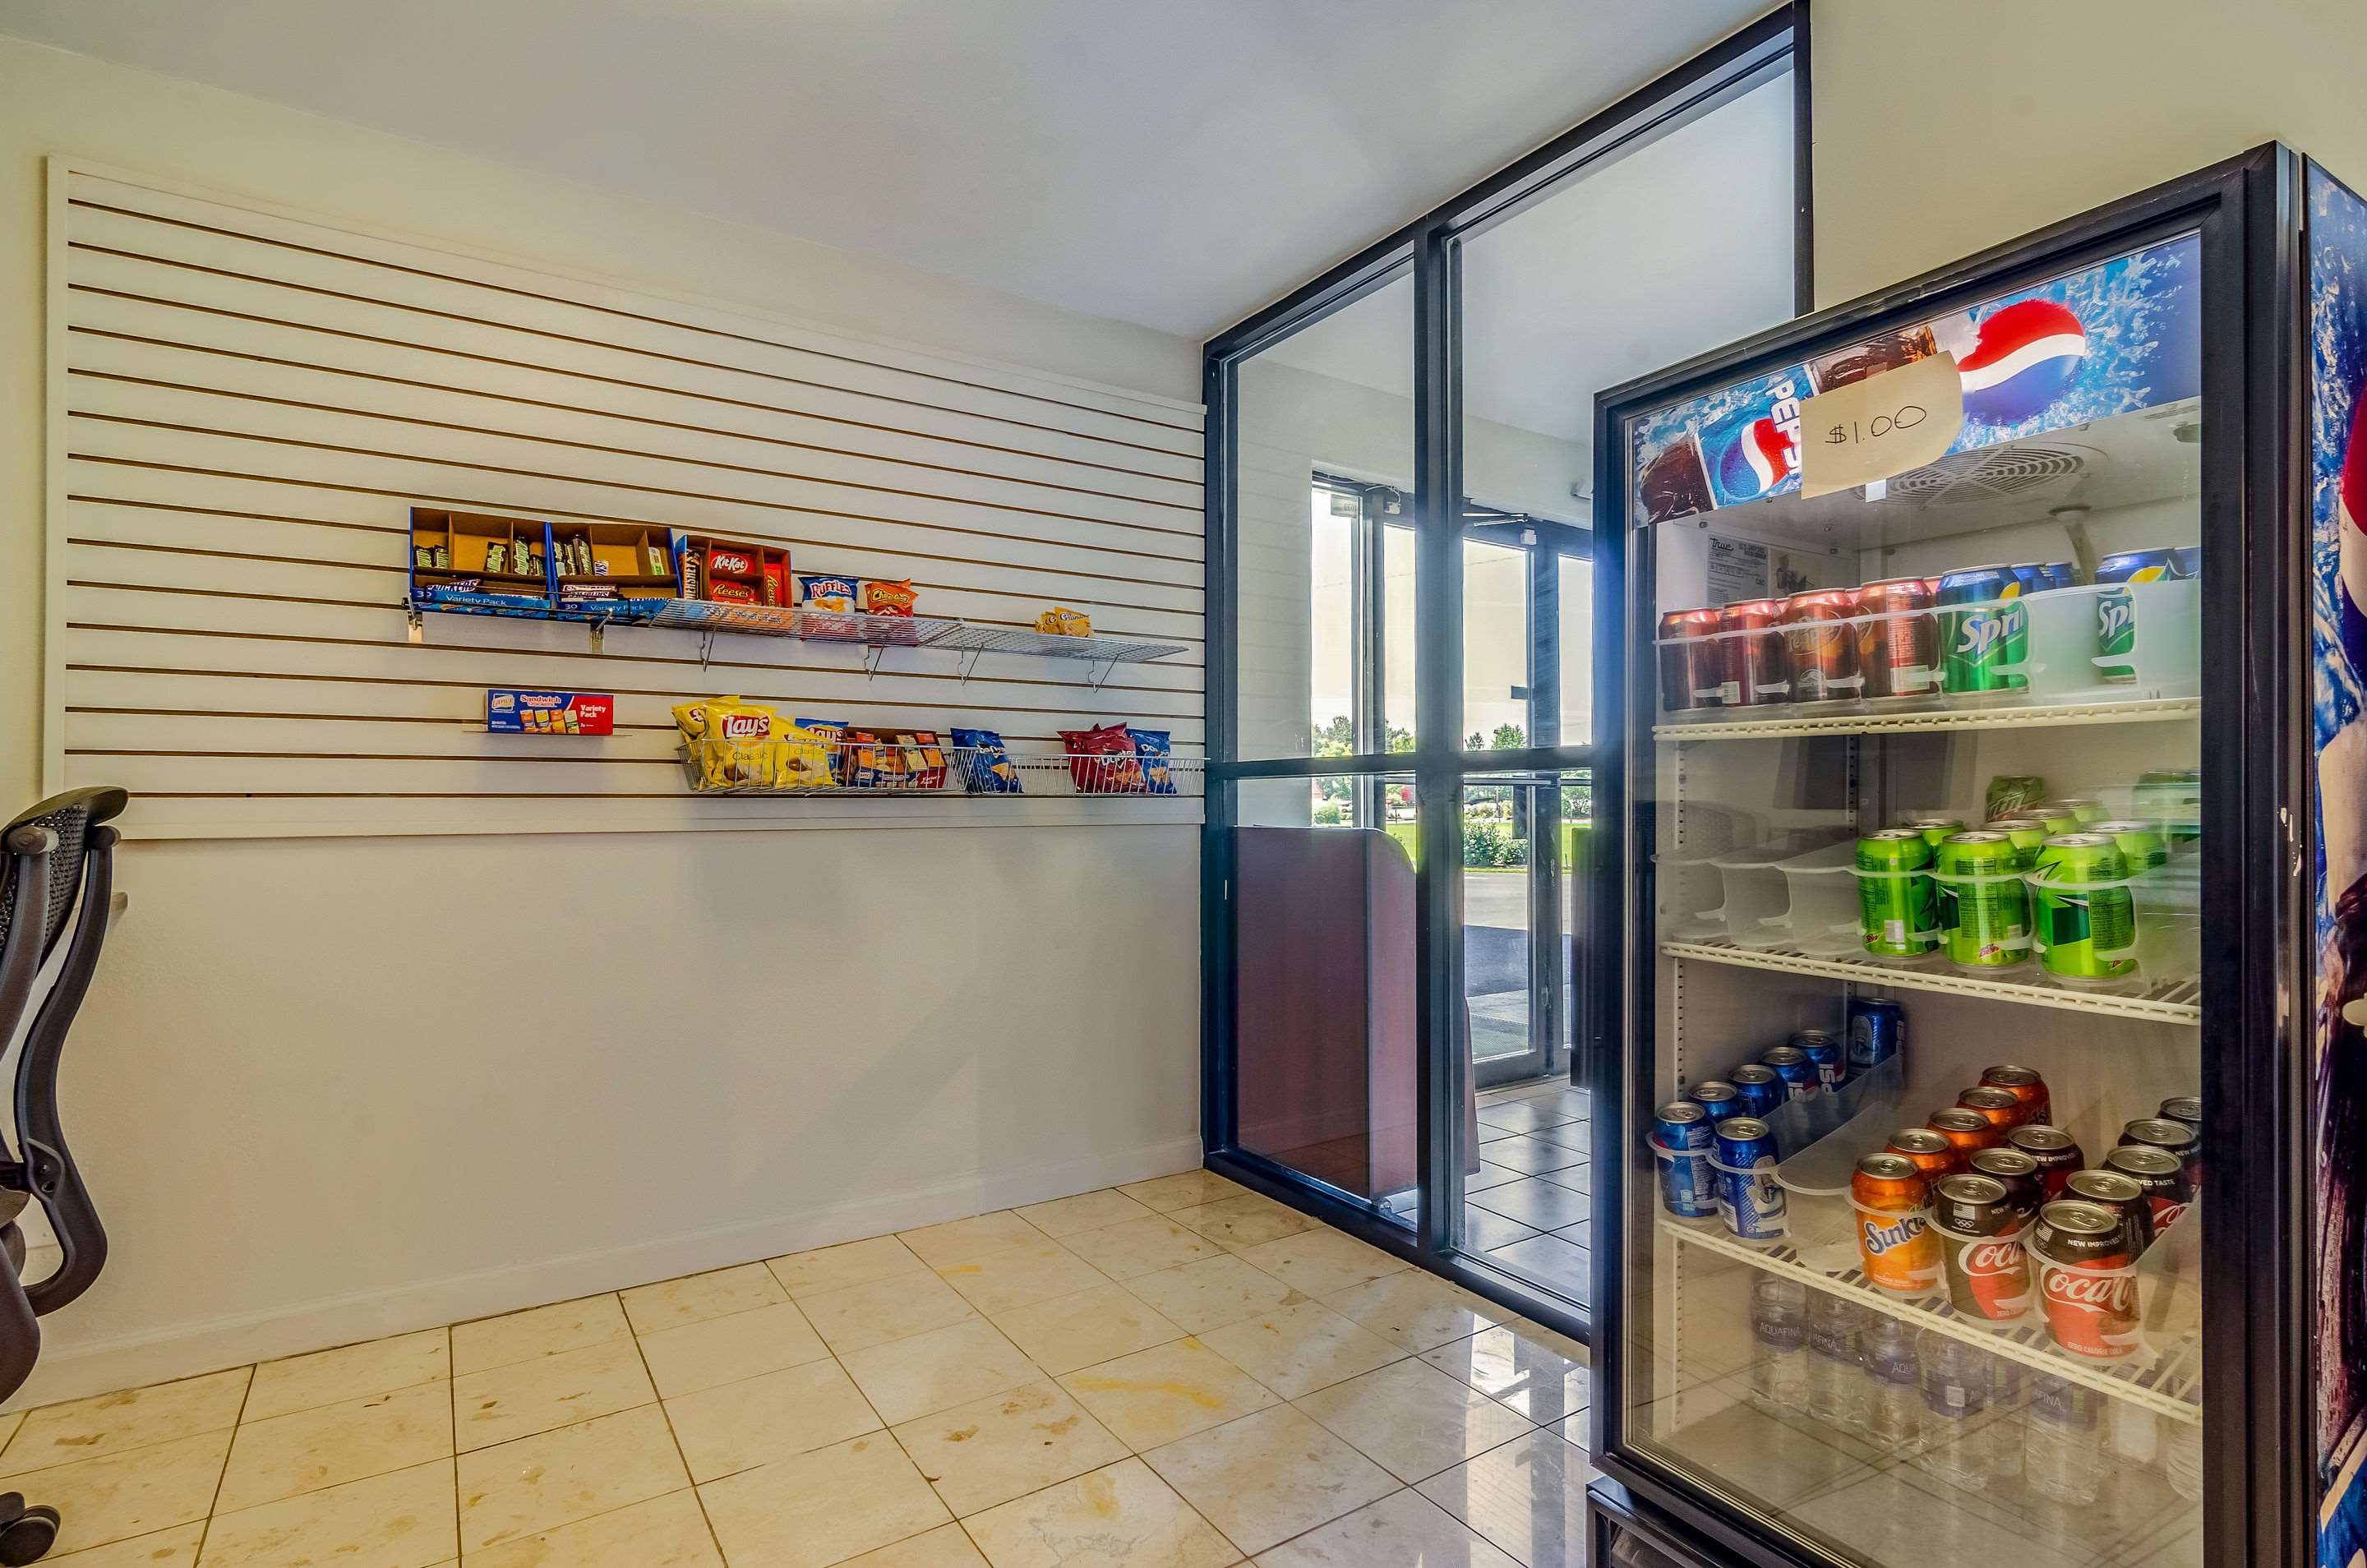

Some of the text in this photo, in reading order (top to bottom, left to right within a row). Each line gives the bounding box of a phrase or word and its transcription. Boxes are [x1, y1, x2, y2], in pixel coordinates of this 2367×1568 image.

[1825, 405, 1927, 445] $1.00
[810, 579, 852, 599] RUFFLES
[445, 594, 482, 604] Variety
[482, 597, 507, 606] Pack
[520, 694, 561, 705] Sandwich
[579, 704, 607, 713] Variety
[579, 710, 598, 718] Pack
[731, 750, 768, 762] Classic
[2153, 1178, 2176, 1187] TASTE
[2067, 1237, 2120, 1247] NEW IMPROVED
